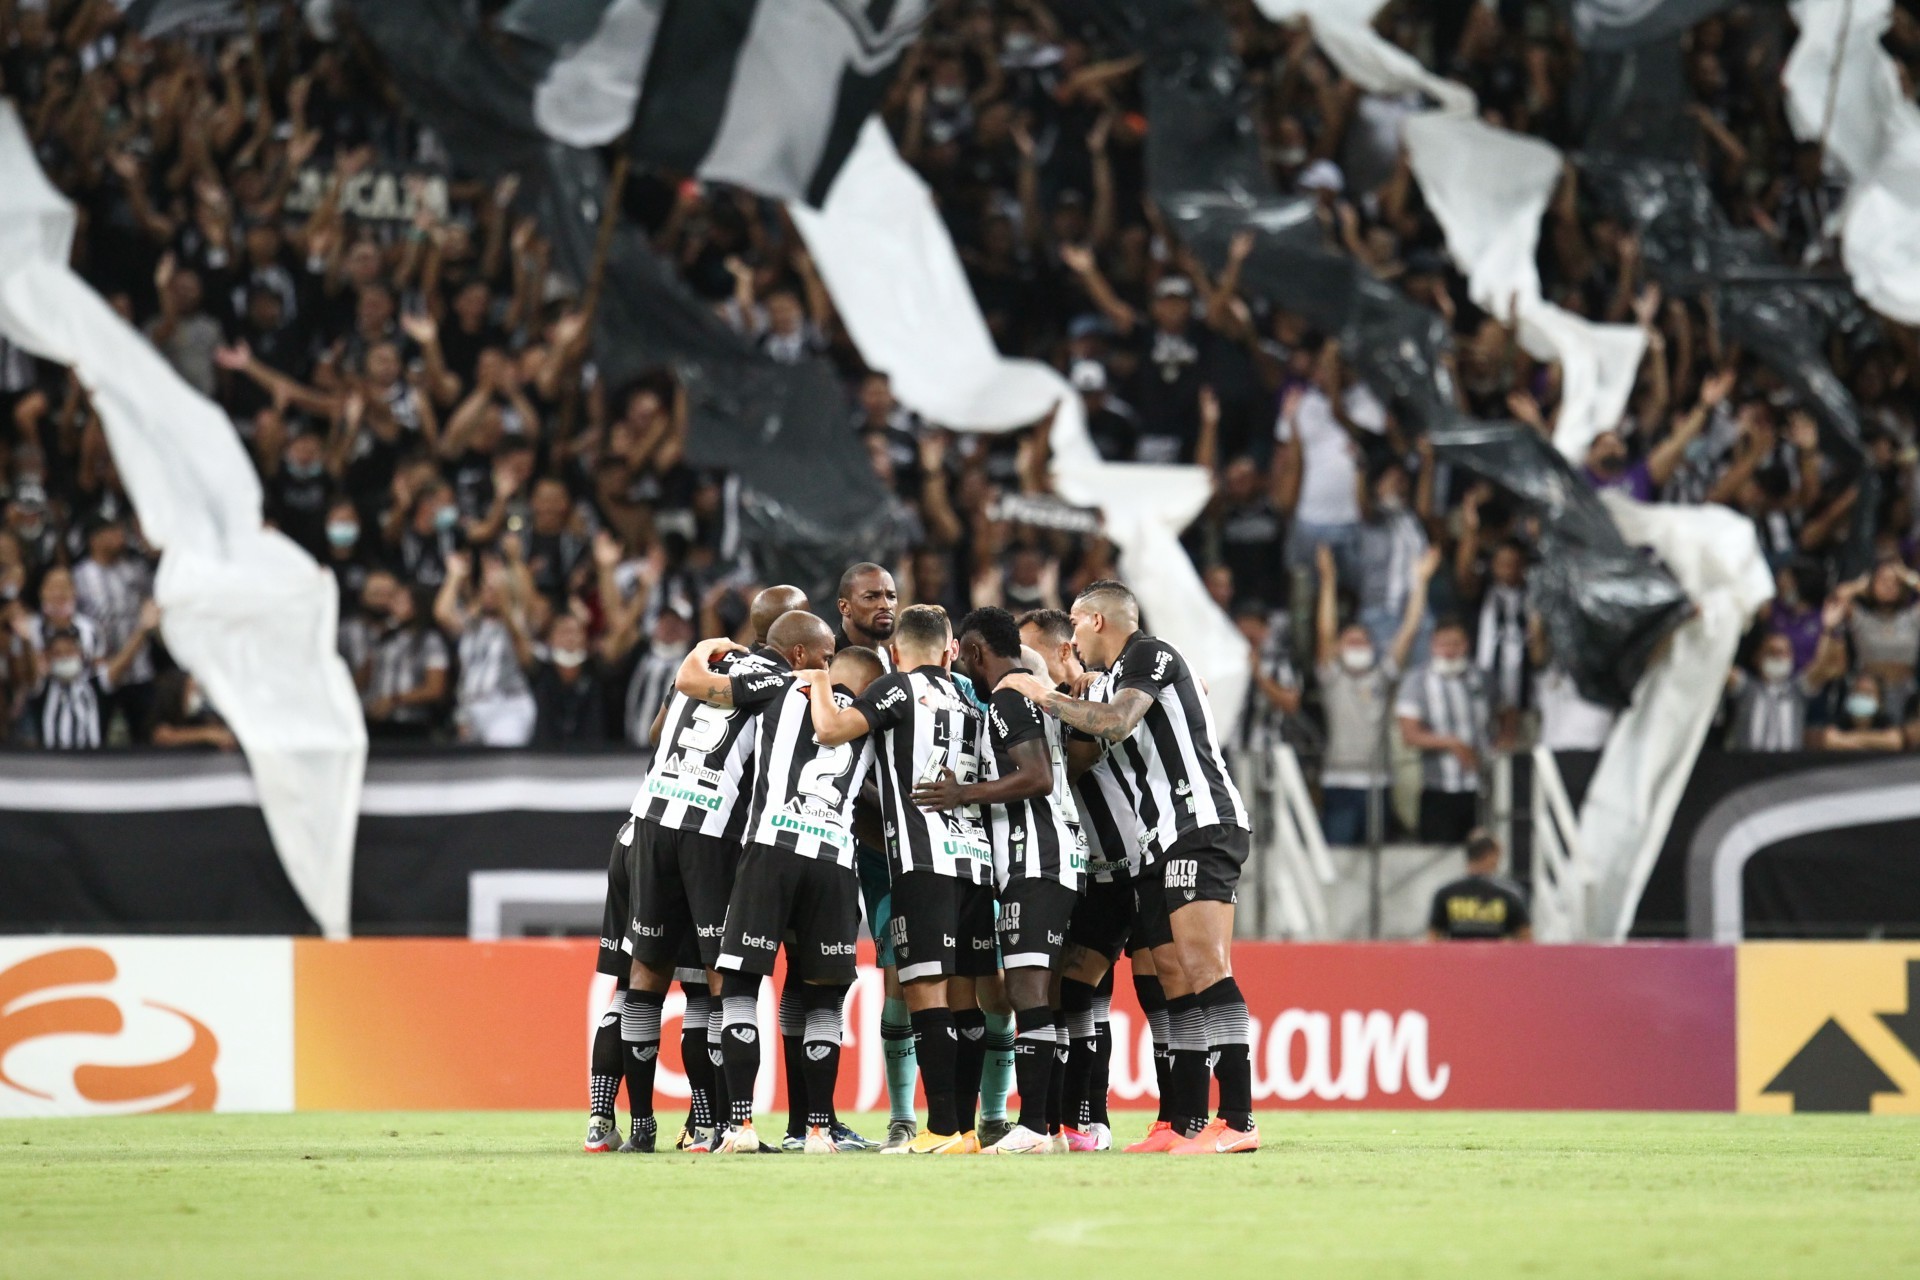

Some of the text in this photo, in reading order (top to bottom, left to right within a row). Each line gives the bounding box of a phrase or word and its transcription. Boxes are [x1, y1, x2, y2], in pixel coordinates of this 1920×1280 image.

[1154, 651, 1173, 676] bmg
[755, 677, 785, 690] bmg
[880, 688, 908, 708] bmg
[677, 702, 740, 754] 3
[991, 710, 1008, 739] bmg
[681, 761, 722, 783] Sabemi
[796, 733, 854, 808] 2
[648, 779, 724, 812] Unimed
[771, 814, 849, 849] Unimed
[943, 840, 993, 863] Unime
[1165, 859, 1198, 876] AUTO
[1165, 874, 1197, 889] TRUCK
[999, 902, 1021, 920] UTO
[696, 924, 725, 938] bets
[889, 915, 907, 936] UTO
[600, 937, 619, 952] sul
[742, 931, 777, 952] bets
[821, 941, 857, 956] bets
[972, 937, 994, 950] bet
[1014, 1045, 1036, 1055] SC
[996, 1059, 1014, 1067] CS
